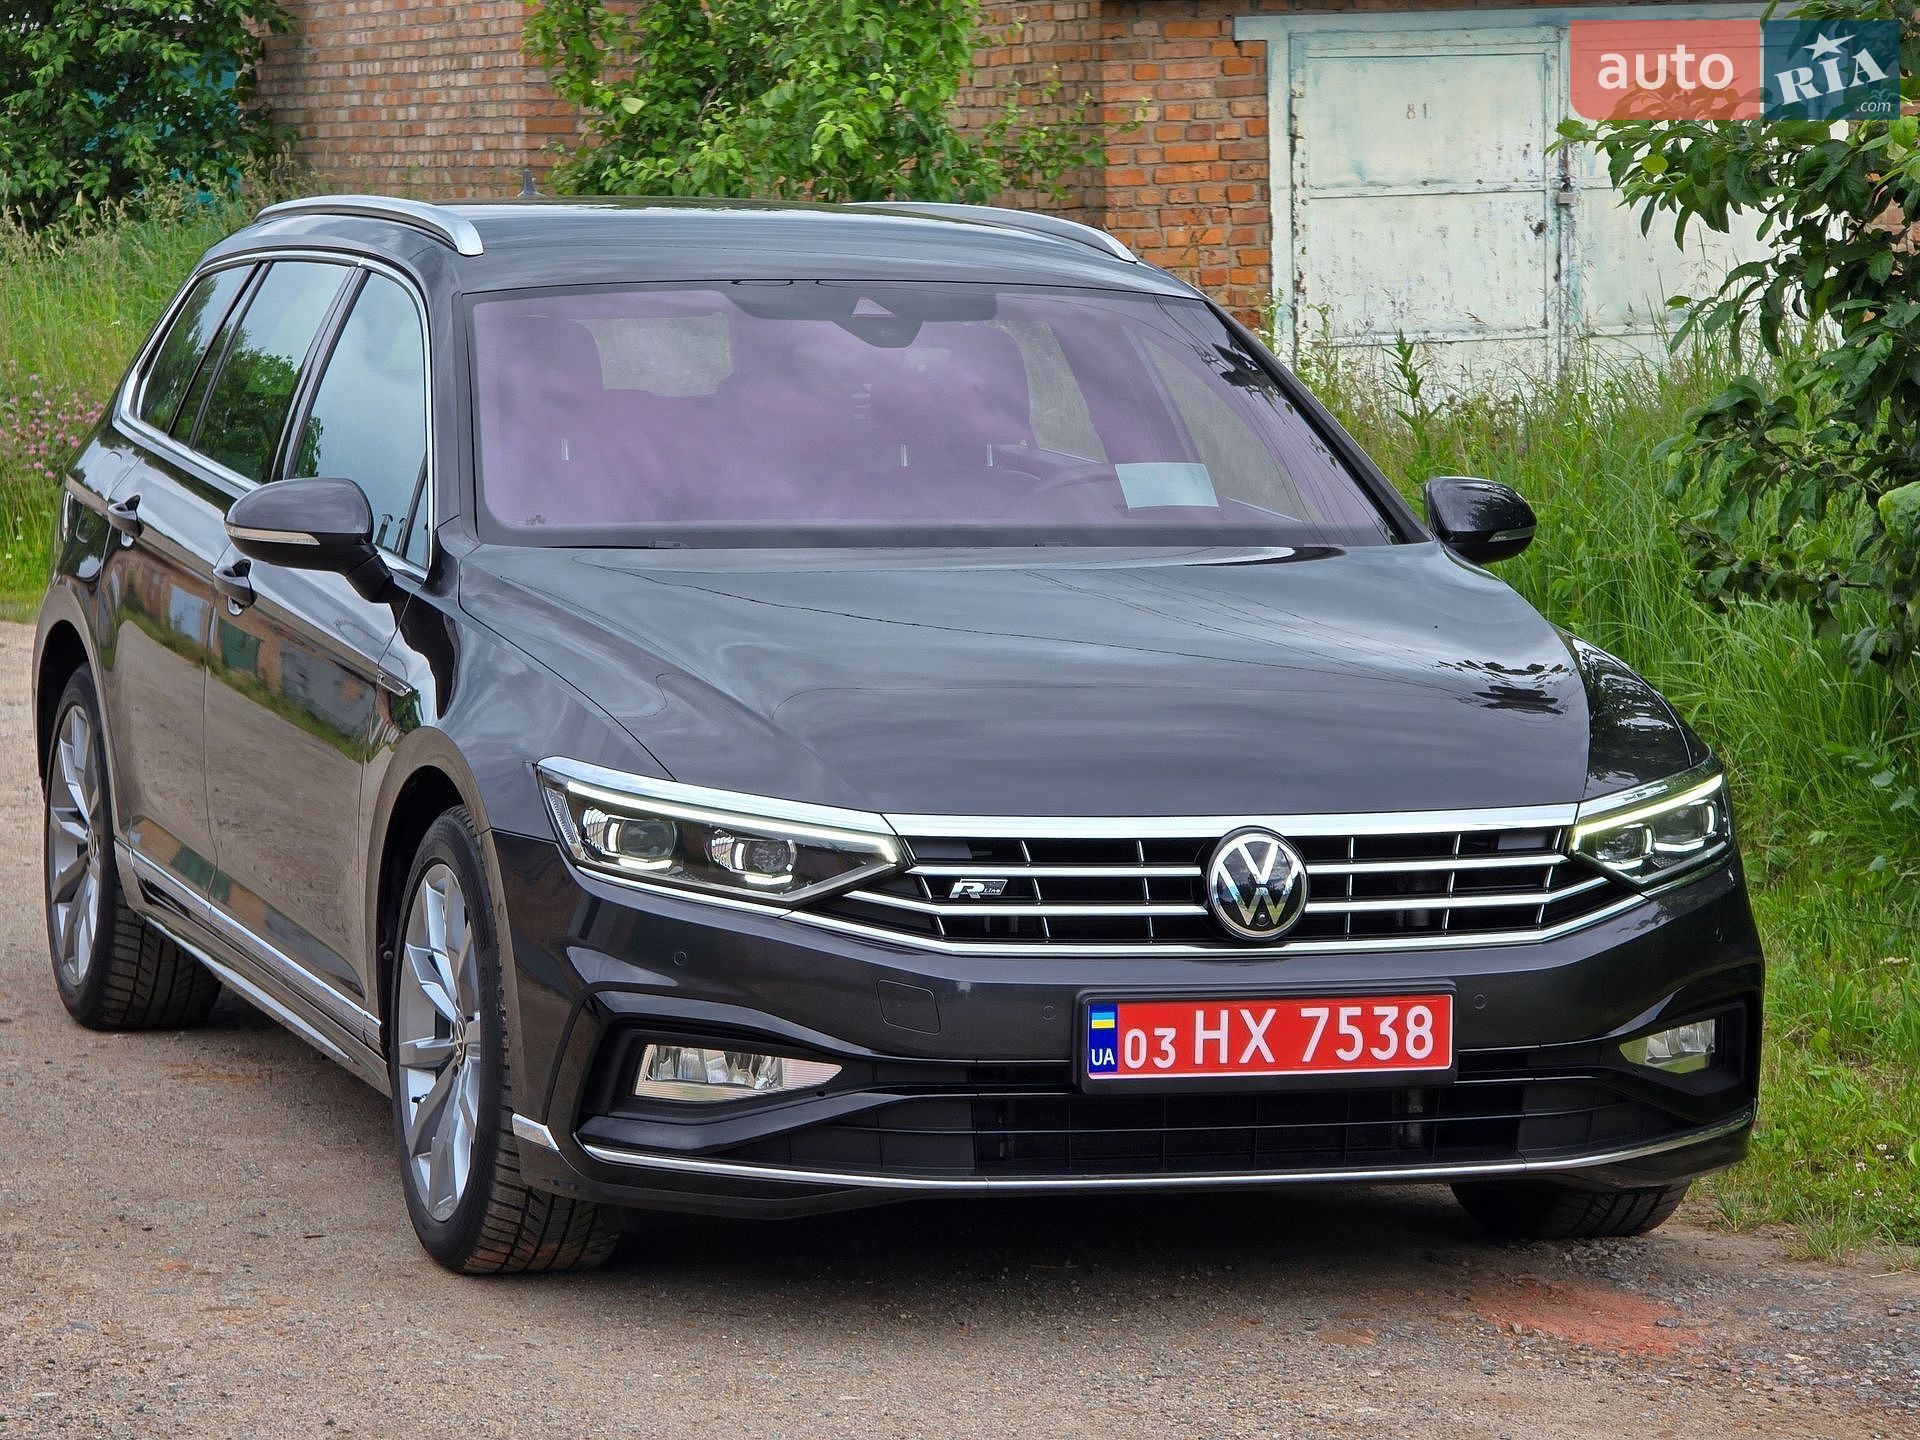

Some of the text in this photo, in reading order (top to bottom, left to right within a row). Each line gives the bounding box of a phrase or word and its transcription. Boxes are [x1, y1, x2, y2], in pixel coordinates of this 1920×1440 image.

[1091, 1047, 1116, 1066] UA
[1124, 1005, 1434, 1069] 03 HX 7538
